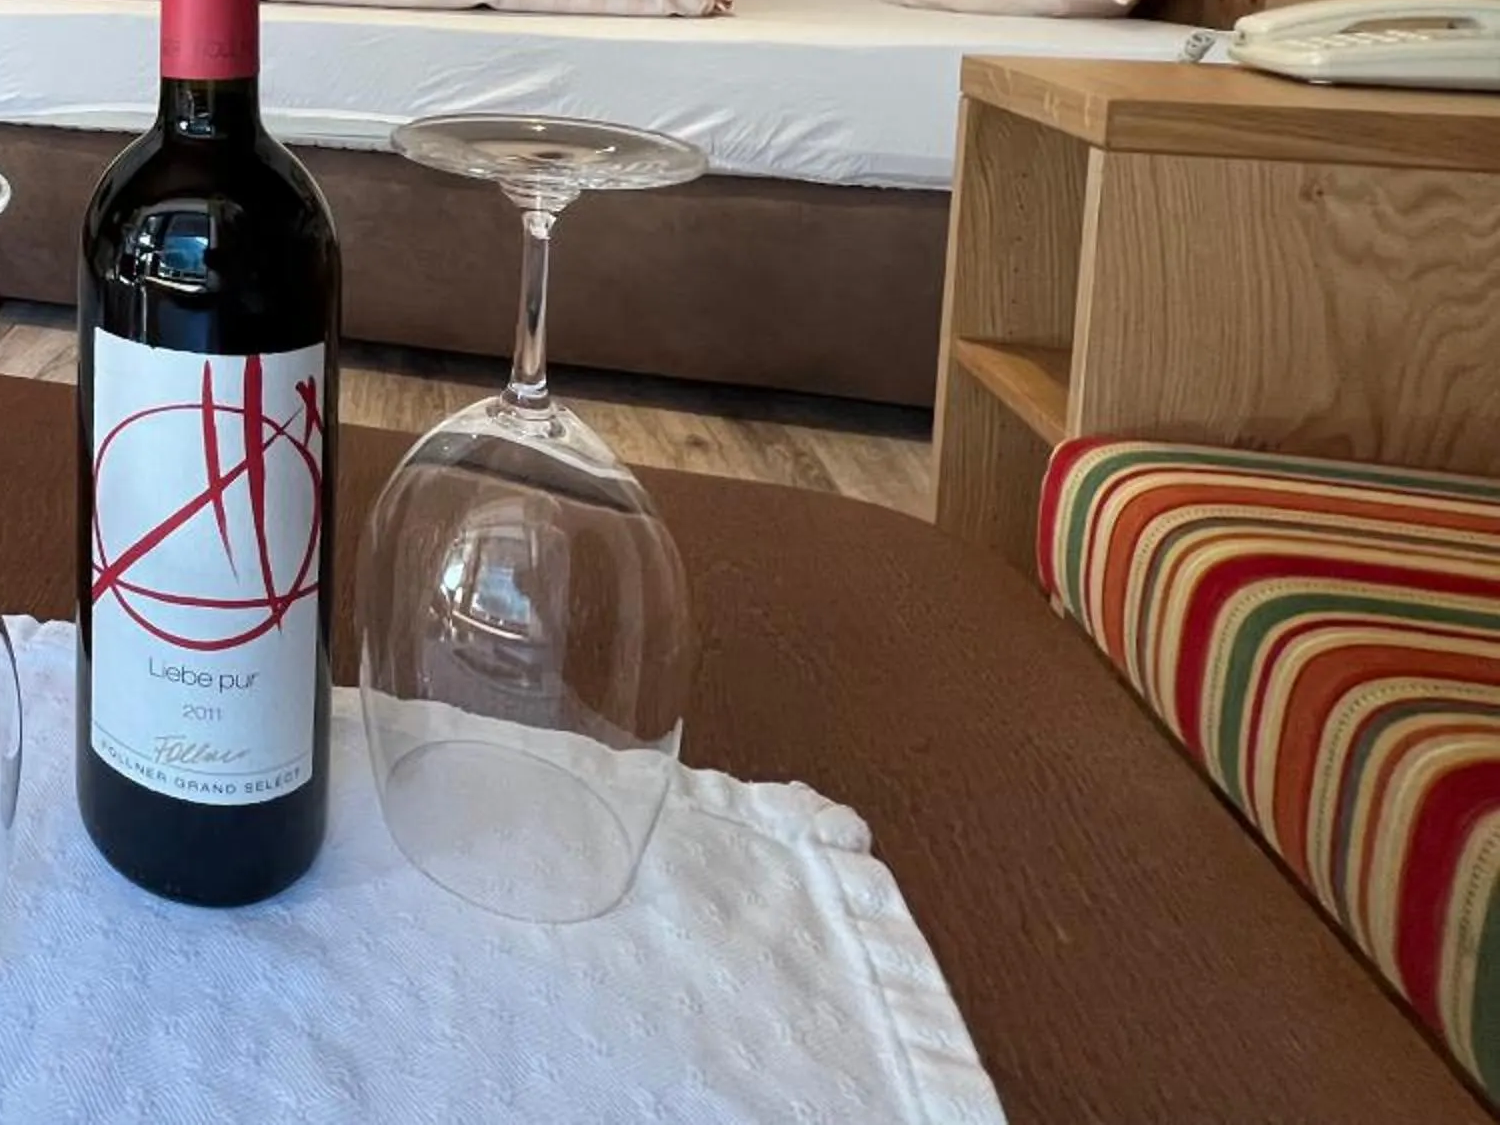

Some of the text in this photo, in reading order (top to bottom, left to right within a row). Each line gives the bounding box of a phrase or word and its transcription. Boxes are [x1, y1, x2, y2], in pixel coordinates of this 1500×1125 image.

[149, 657, 260, 694] Liebe pur
[182, 704, 222, 721] 2011
[174, 777, 236, 795] GRAND
[243, 766, 301, 794] SELECT
